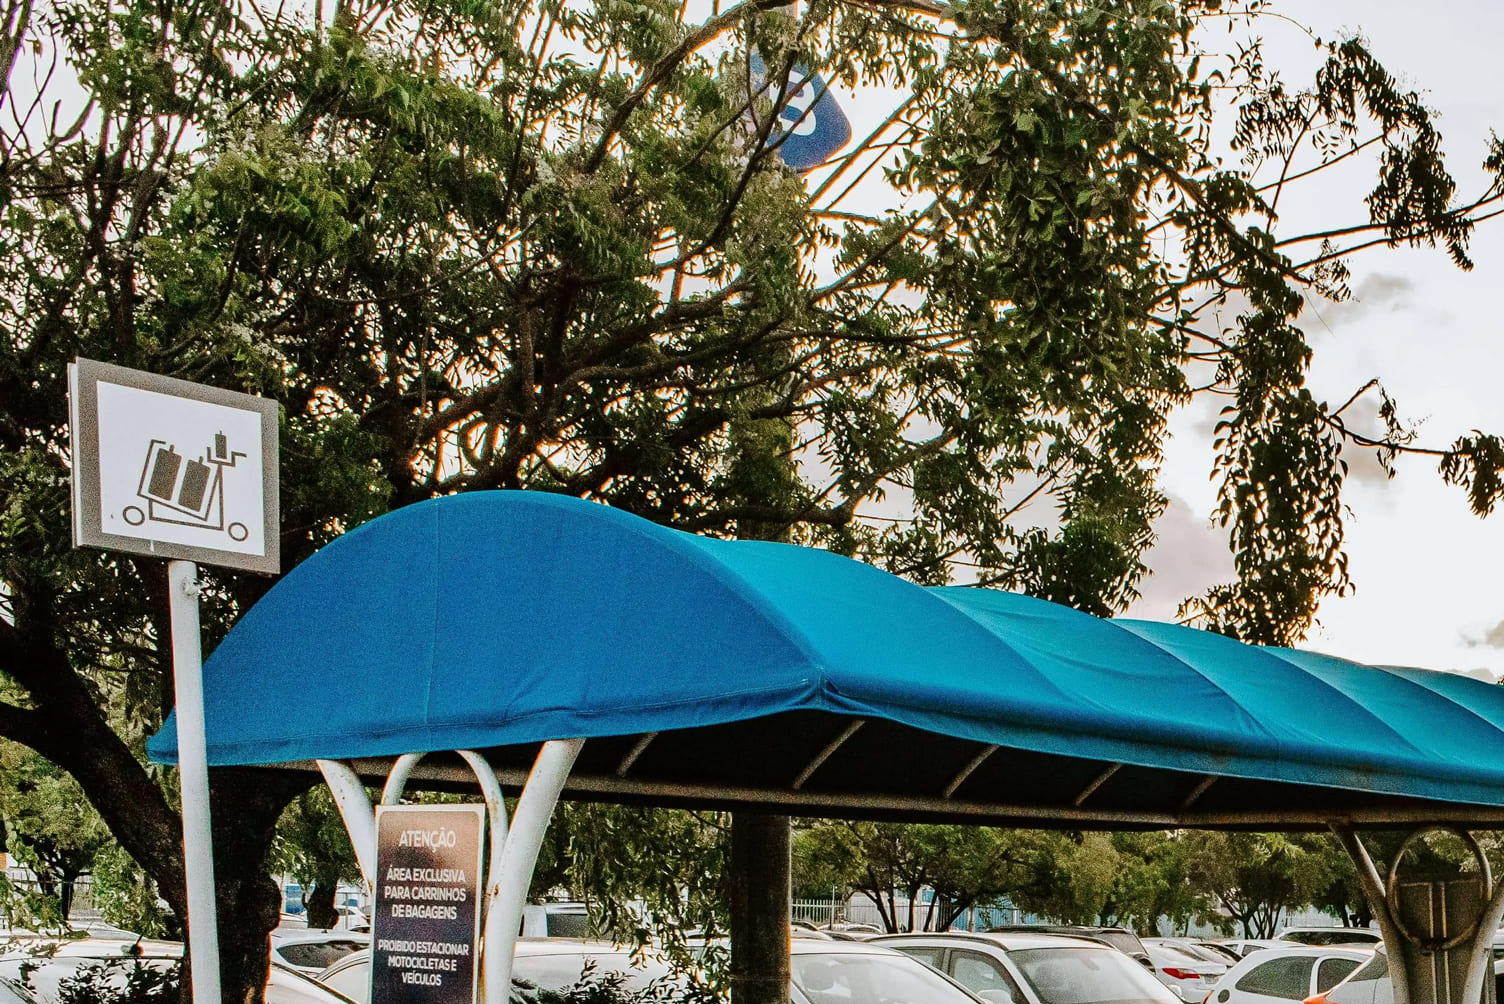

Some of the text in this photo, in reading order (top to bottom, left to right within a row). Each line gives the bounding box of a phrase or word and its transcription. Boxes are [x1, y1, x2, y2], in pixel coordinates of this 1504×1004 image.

[398, 826, 456, 853] ATENÇÃO
[386, 864, 466, 882] ÁREA EXCLUSIVA
[384, 886, 466, 902] PARA CARRINHOS
[391, 904, 457, 920] DE BAGAGENS
[378, 939, 470, 956] PROIBIDO ESTACIONAR
[388, 955, 457, 971] MOTOCICLETAS E
[402, 970, 442, 986] VEÍCULOS
